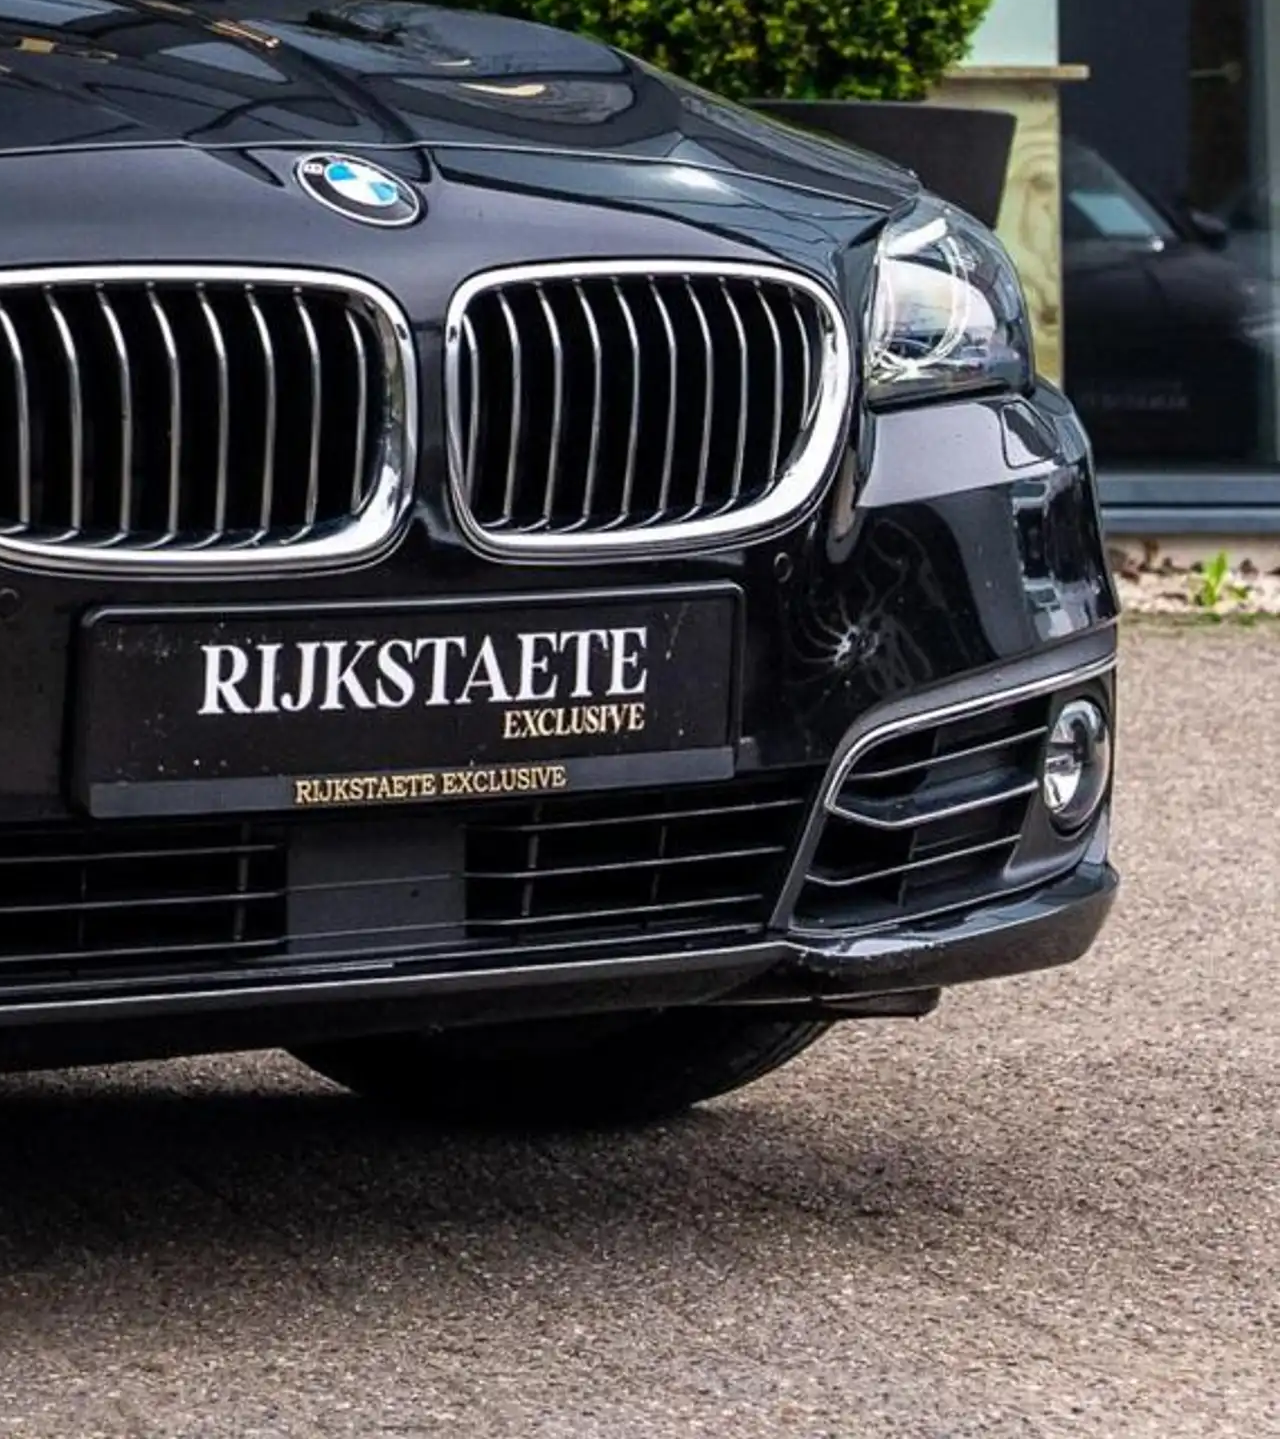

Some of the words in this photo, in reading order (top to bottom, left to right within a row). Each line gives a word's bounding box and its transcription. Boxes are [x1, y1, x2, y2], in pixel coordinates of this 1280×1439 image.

[197, 626, 648, 715] RIJKSTAETE
[502, 702, 646, 740] EXCLUSIVE
[294, 772, 436, 805] RIJKSTAETE
[440, 764, 568, 796] EXCLUSIVE
